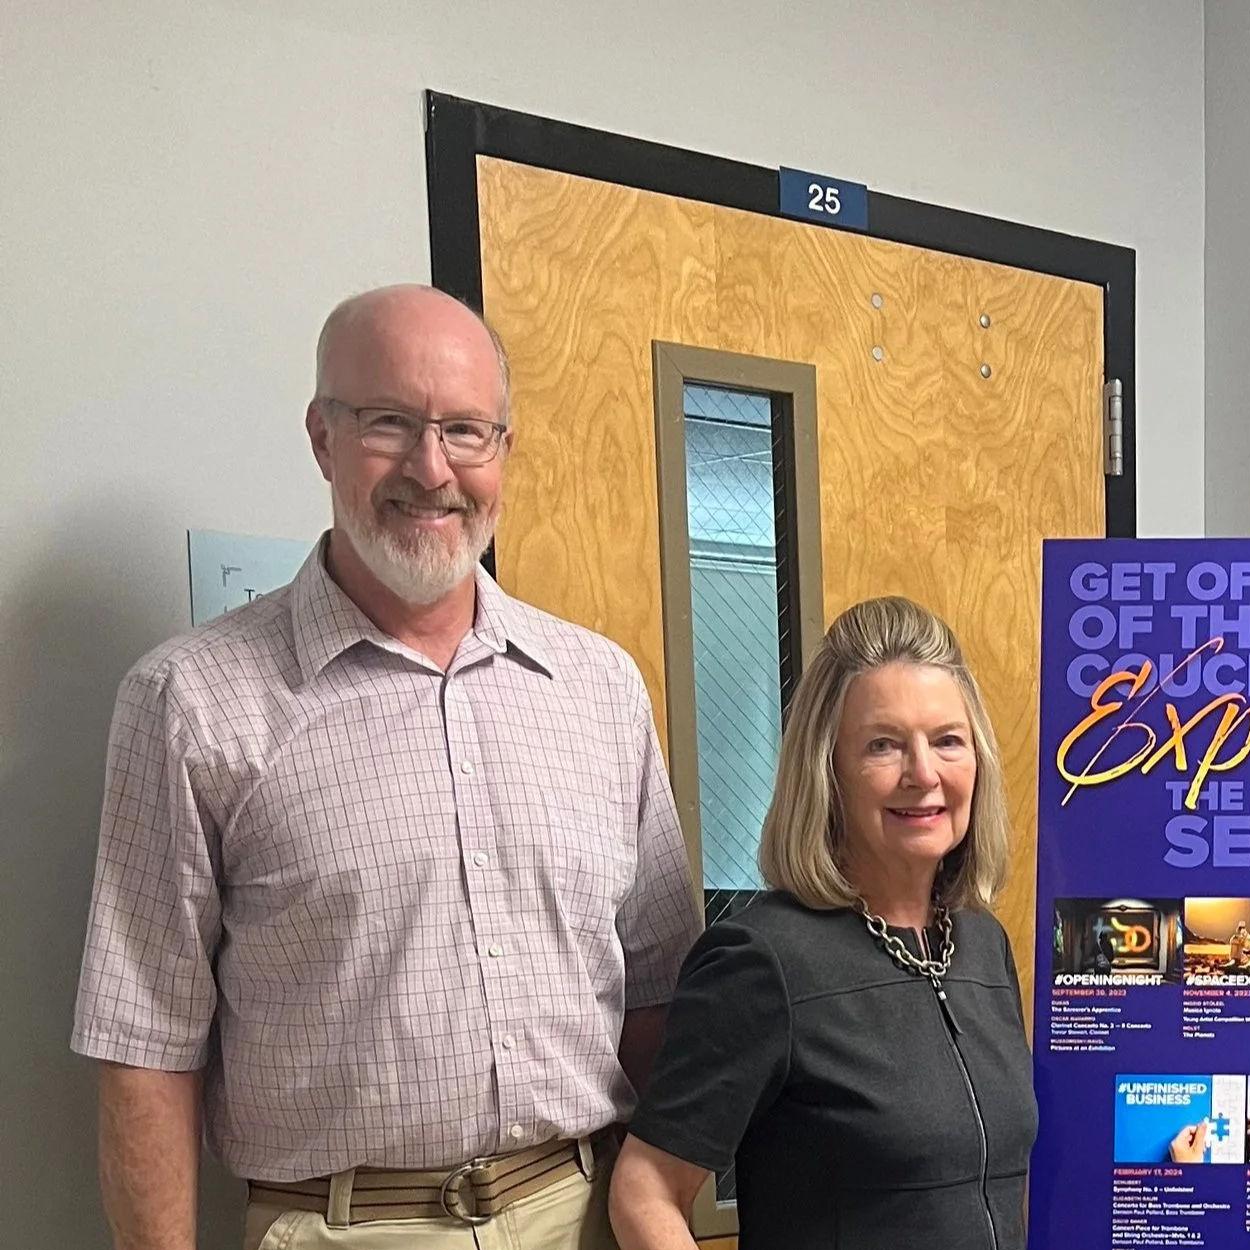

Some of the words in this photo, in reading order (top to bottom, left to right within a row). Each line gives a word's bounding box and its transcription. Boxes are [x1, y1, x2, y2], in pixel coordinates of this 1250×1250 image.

[808, 183, 841, 215] 25
[1069, 562, 1176, 601] GET
[1068, 605, 1153, 649] OF
[1165, 781, 1244, 811] THE
[1054, 974, 1164, 986] #OPENINGNIGHT
[1051, 989, 1095, 997] SEPTEMBER
[1118, 1083, 1207, 1095] #UNFINISHED
[1126, 1094, 1192, 1105] BUSINESS
[1113, 1168, 1153, 1176] FEBRUARY
